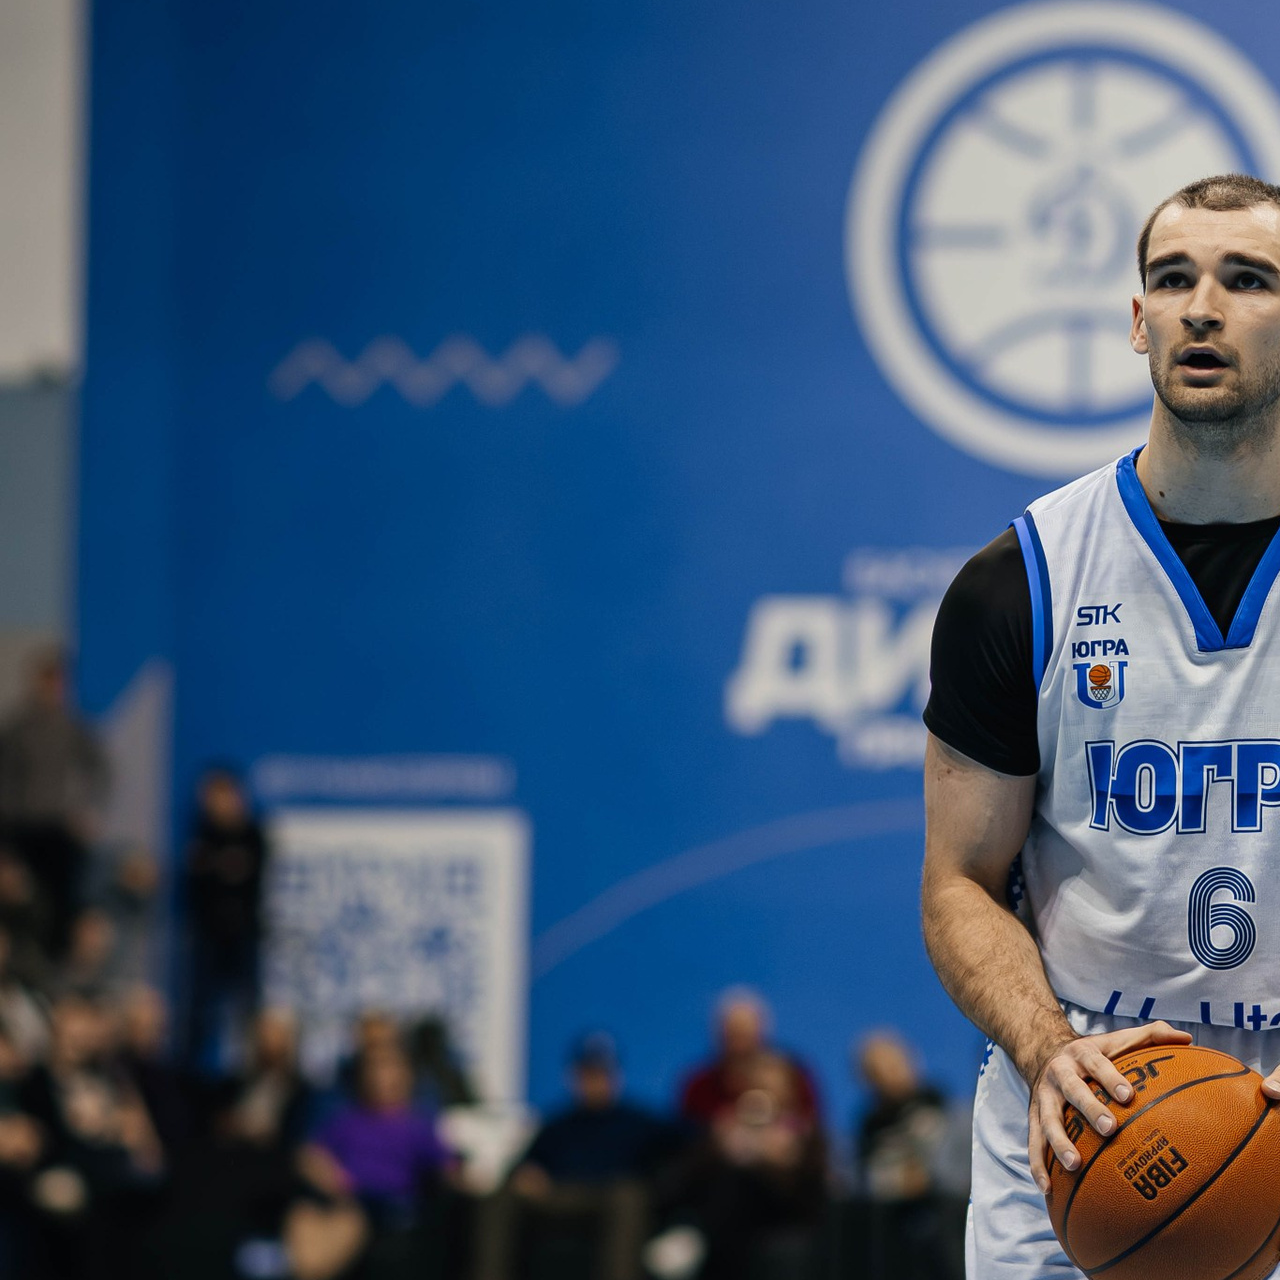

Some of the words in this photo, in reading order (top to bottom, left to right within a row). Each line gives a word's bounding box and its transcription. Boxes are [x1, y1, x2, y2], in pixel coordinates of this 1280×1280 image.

[1076, 603, 1122, 626] STK
[1072, 638, 1129, 659] ЮГРА
[1187, 866, 1257, 971] 6
[1123, 1135, 1170, 1181] APPROVED
[1132, 1146, 1189, 1201] FIBA
